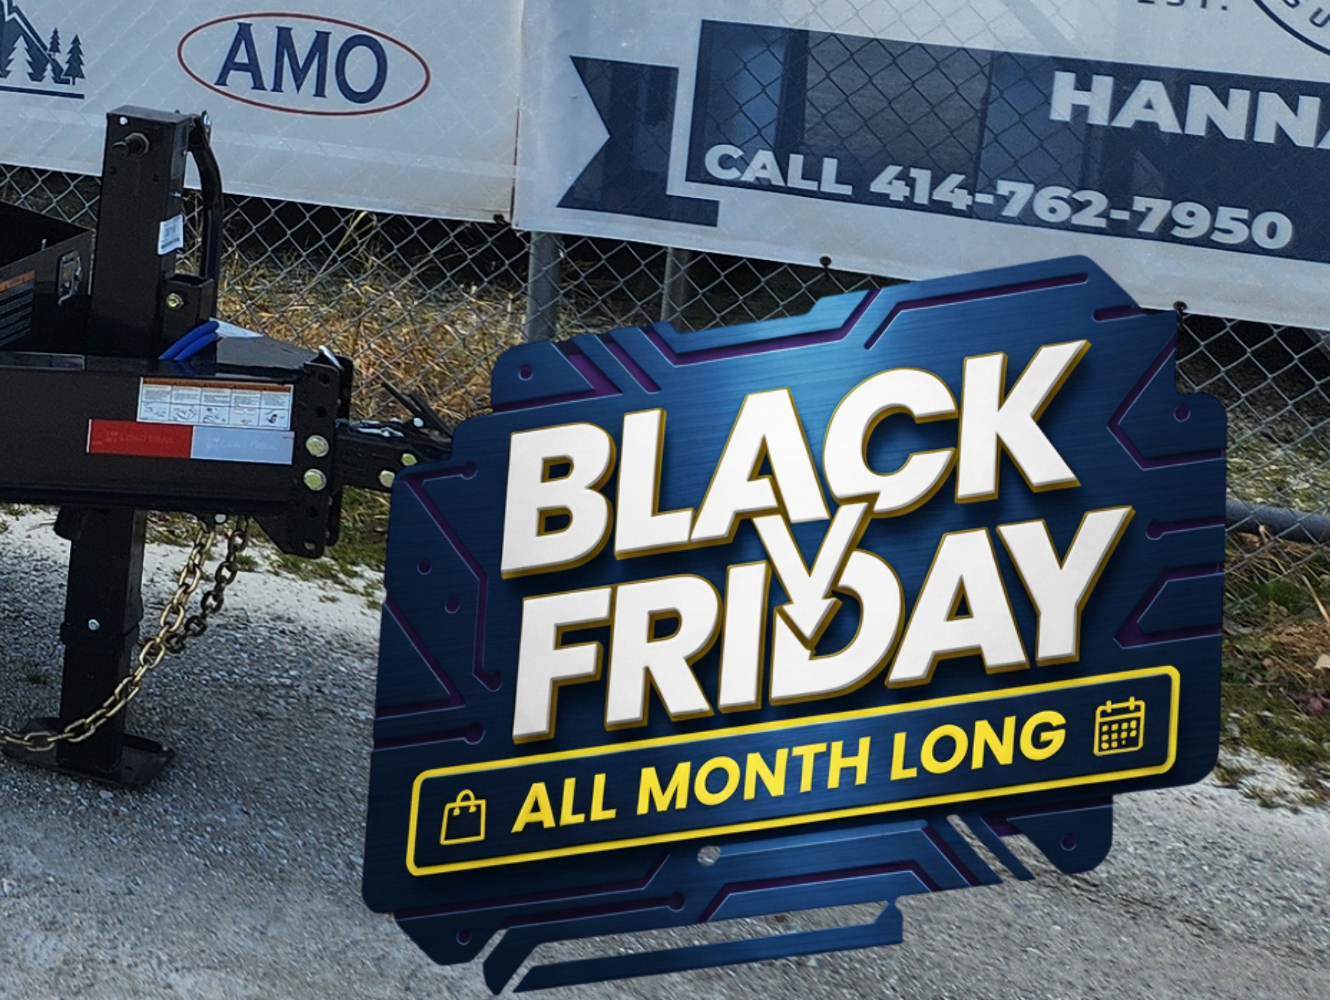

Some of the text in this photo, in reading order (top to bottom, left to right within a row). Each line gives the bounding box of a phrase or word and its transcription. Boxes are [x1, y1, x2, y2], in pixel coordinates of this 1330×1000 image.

[213, 21, 388, 104] AMO
[1049, 70, 1330, 150] HANN
[704, 143, 1293, 250] CALL 414-762-7950
